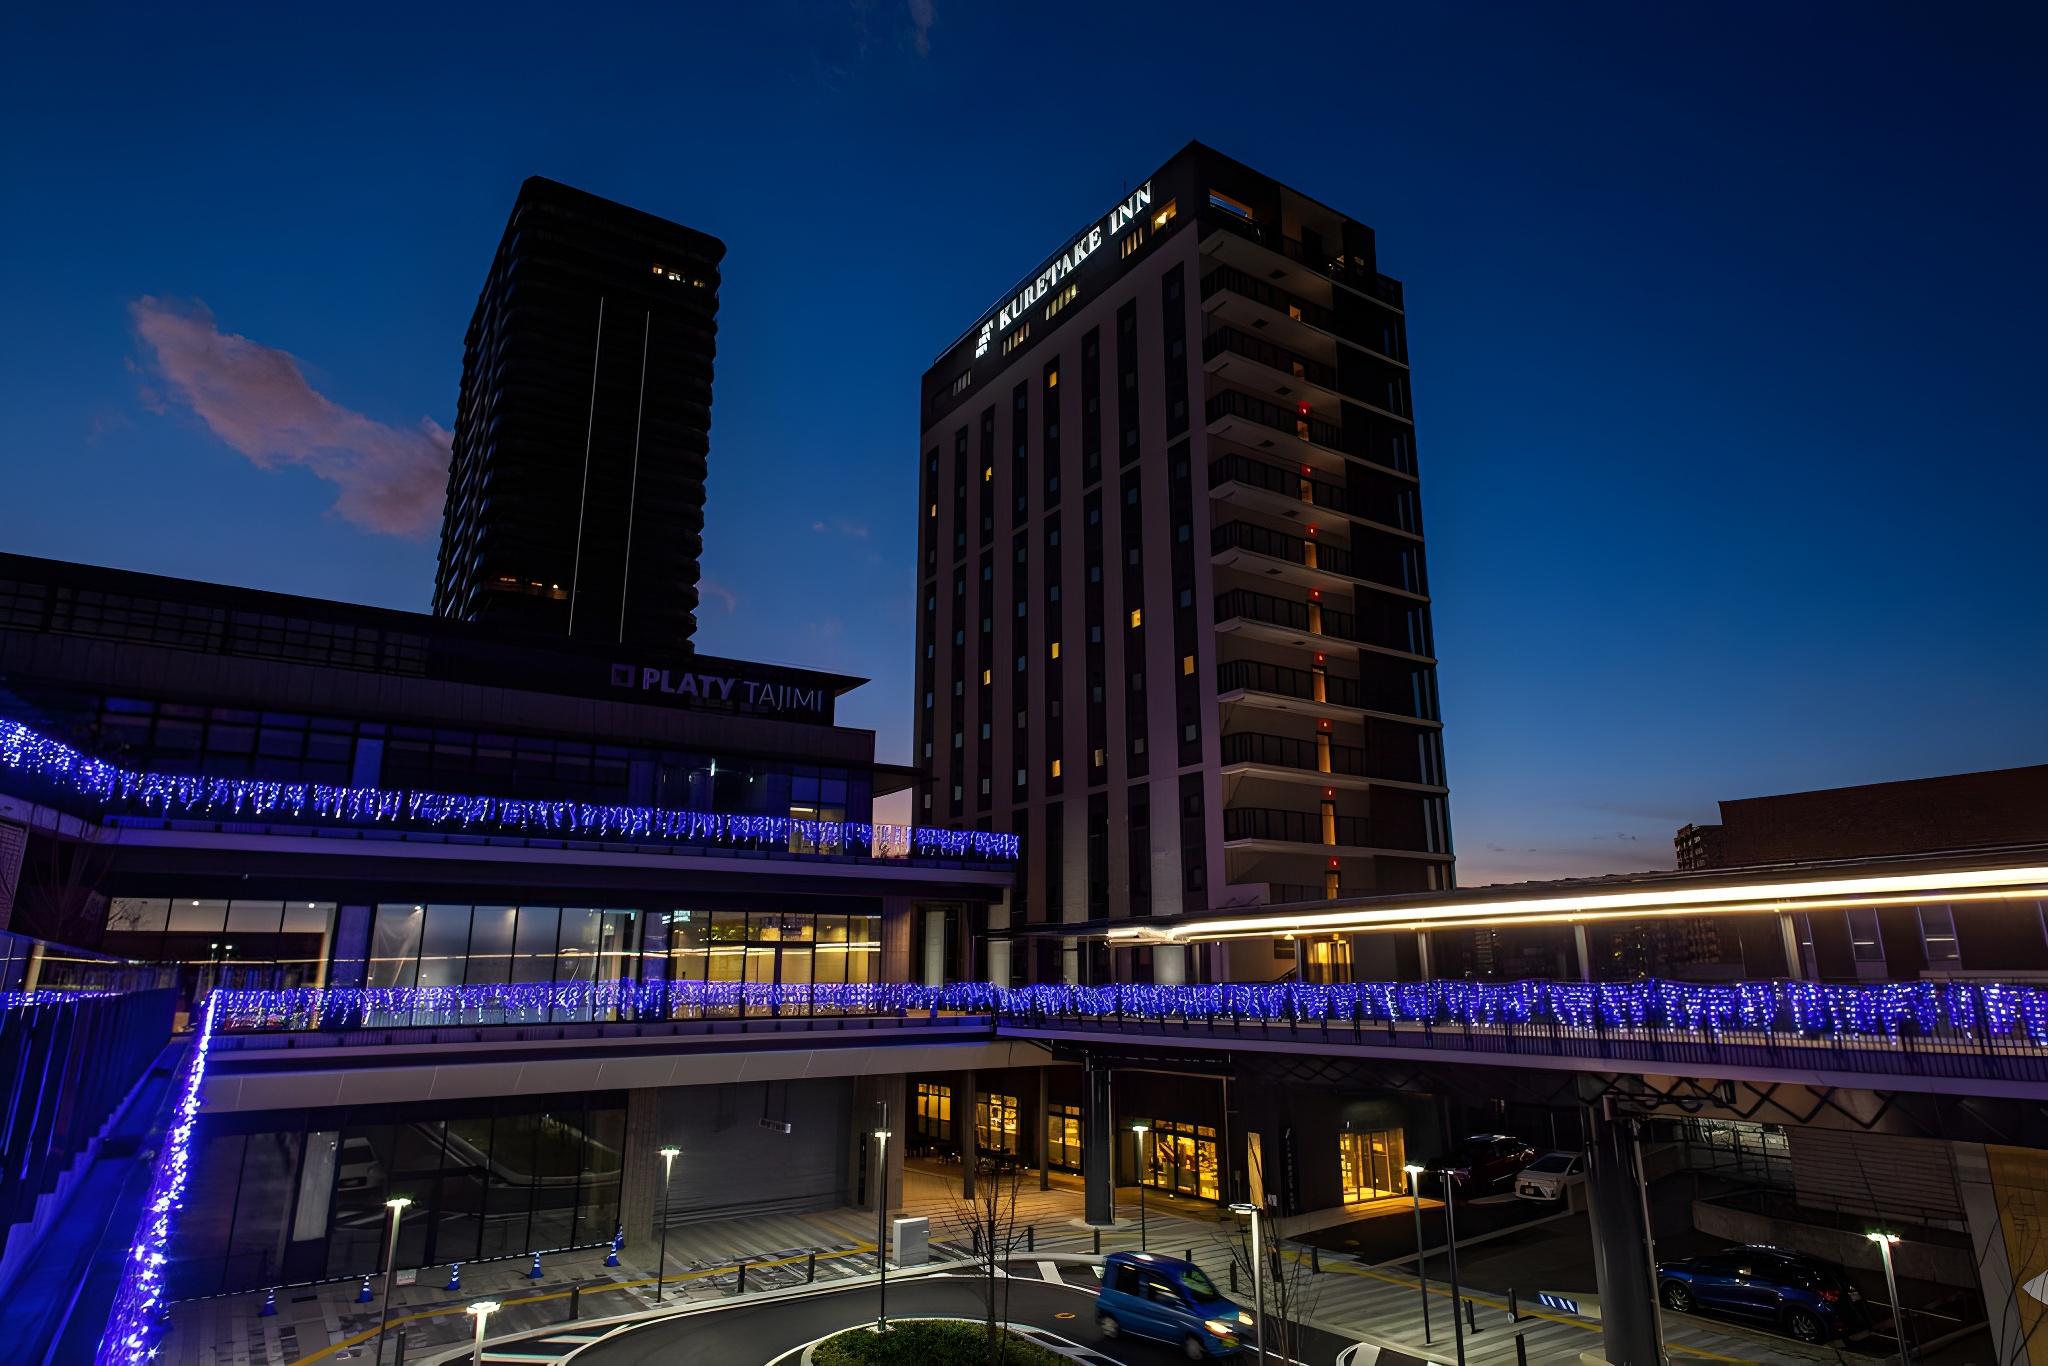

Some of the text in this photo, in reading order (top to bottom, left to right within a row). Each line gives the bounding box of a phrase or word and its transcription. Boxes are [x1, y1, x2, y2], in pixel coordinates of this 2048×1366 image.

[999, 180, 1151, 332] KURETAKE INN
[642, 667, 823, 712] PLATY TAJIMI
